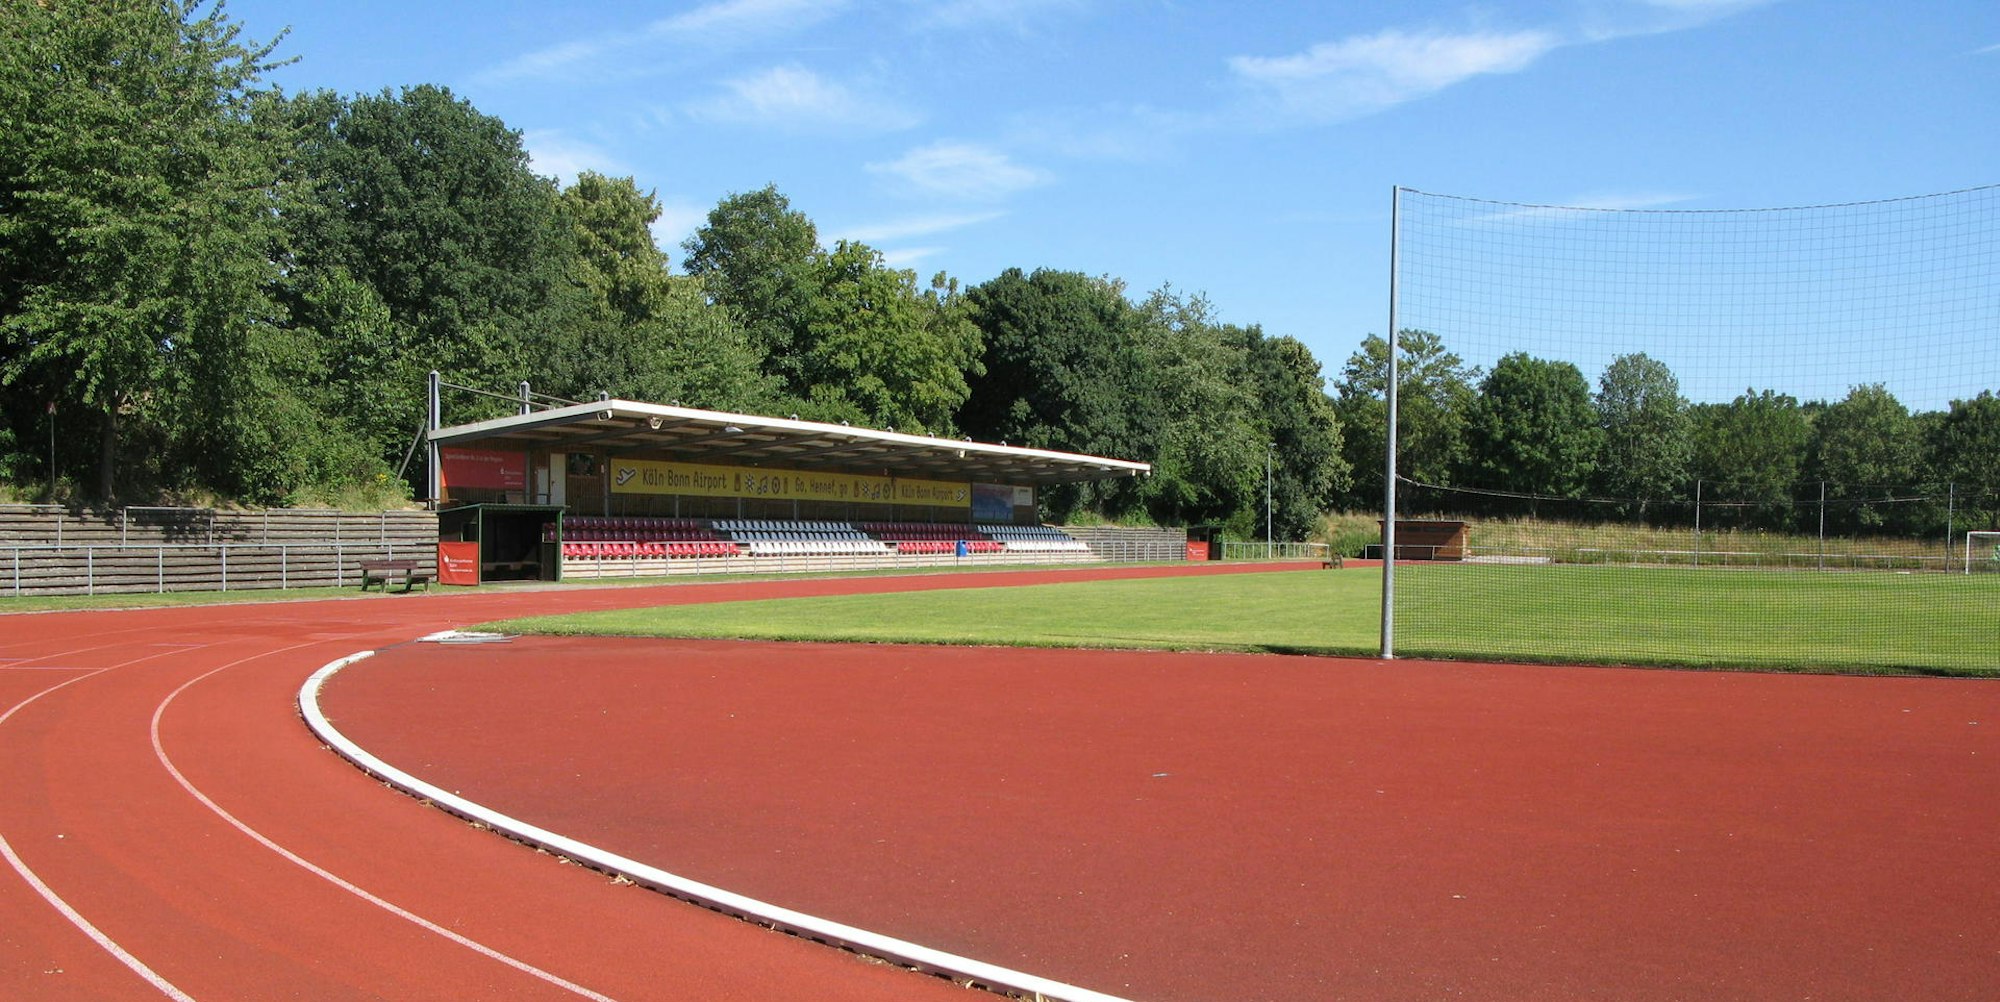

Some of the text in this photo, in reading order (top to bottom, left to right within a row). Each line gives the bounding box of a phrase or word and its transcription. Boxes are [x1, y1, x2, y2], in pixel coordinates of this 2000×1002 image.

[642, 468, 727, 491] Köln Bonn Airport
